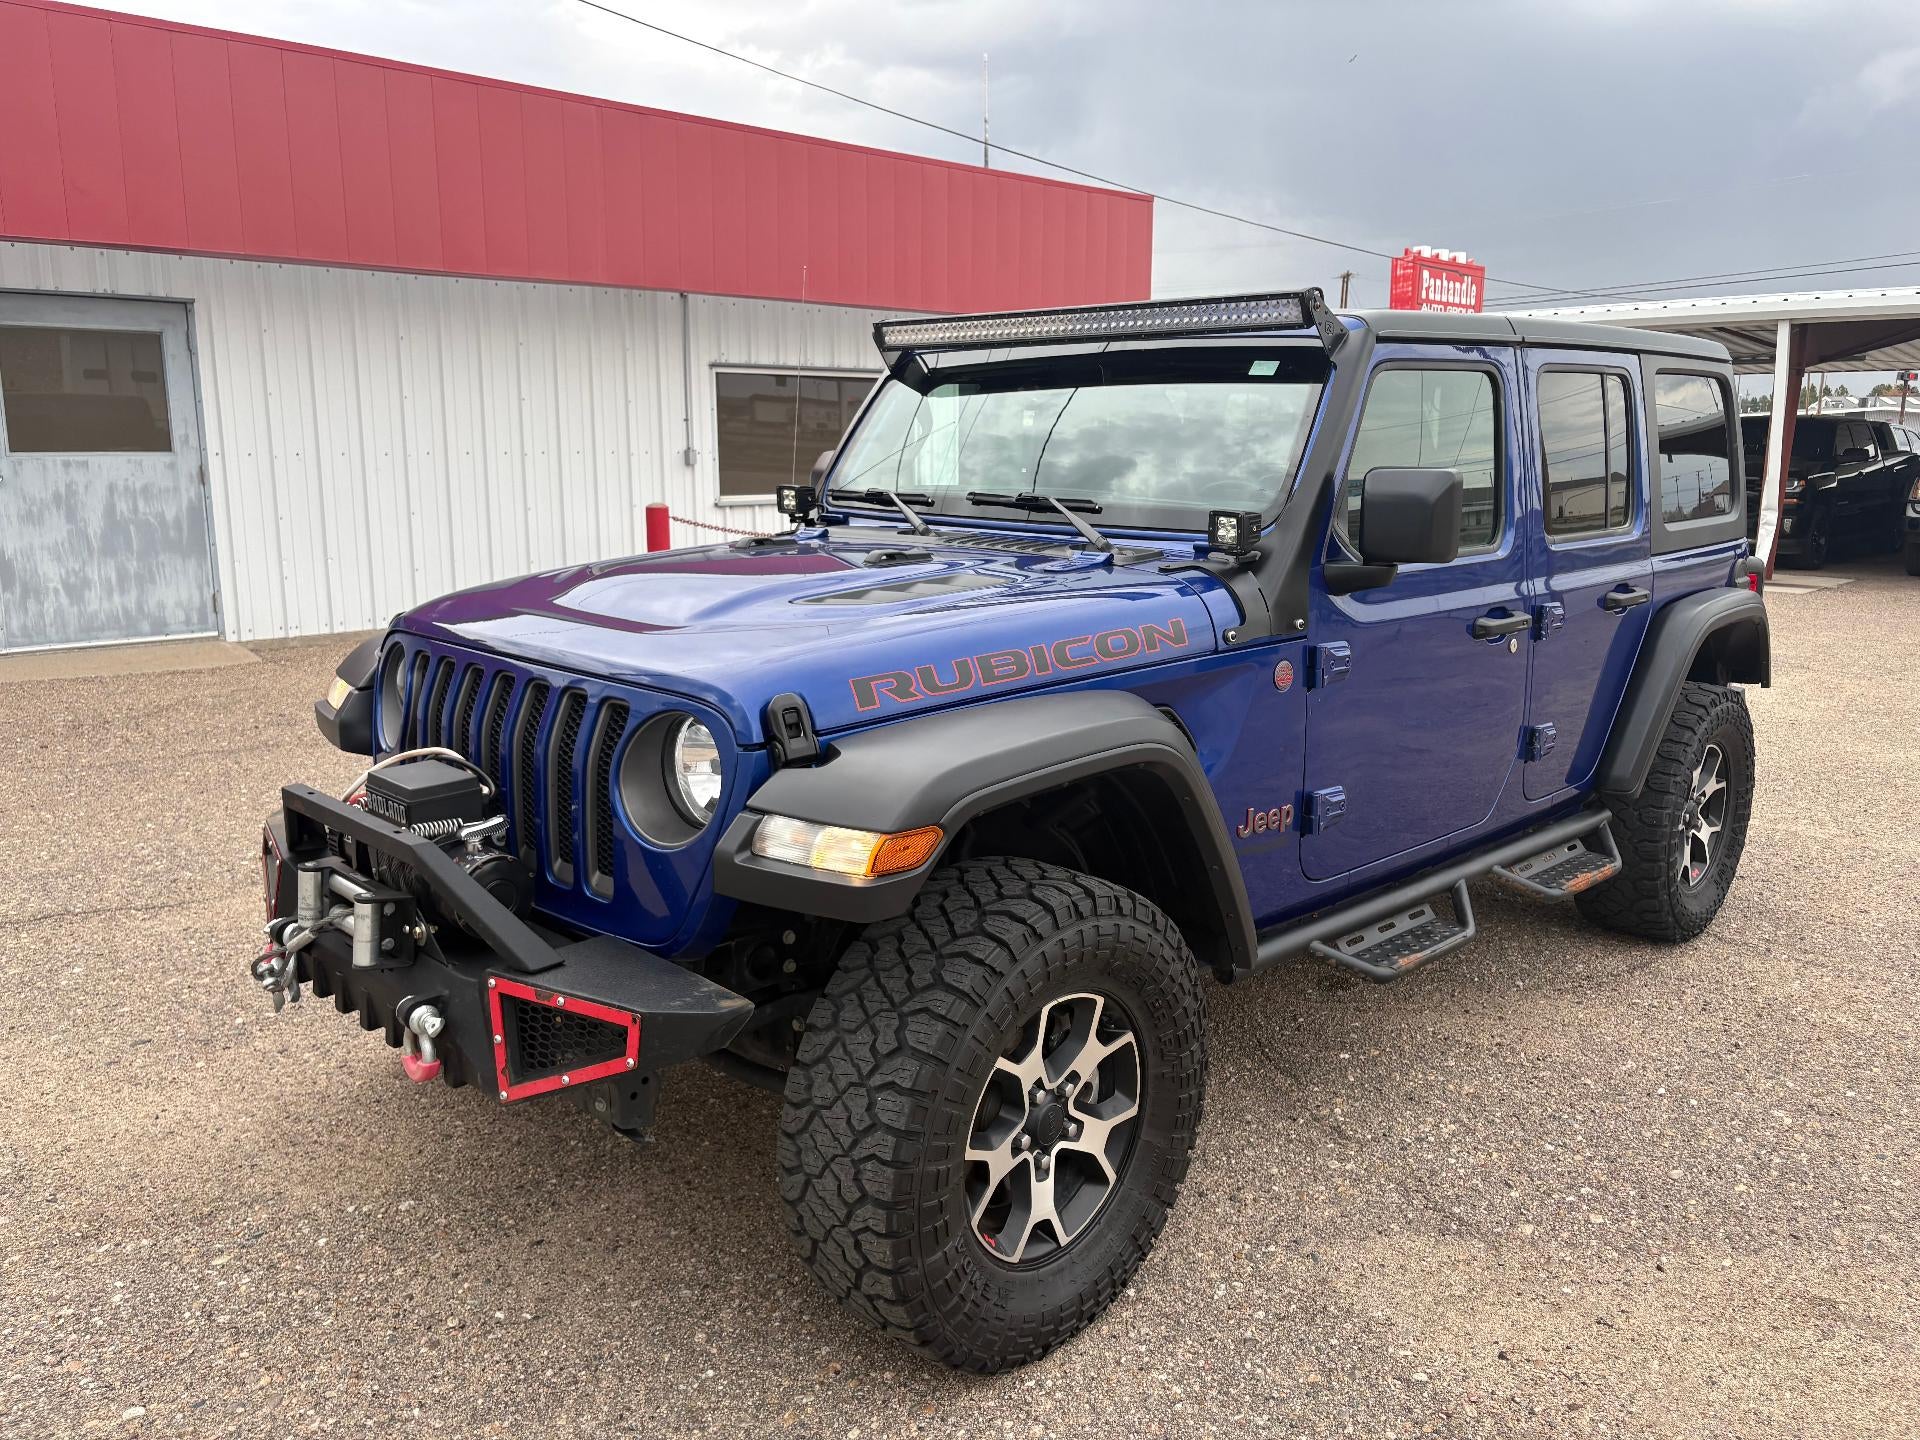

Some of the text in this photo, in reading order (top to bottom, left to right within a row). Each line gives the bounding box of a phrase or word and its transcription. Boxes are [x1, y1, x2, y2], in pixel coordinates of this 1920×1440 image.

[1421, 269, 1477, 306] Panhandle
[1421, 303, 1445, 313] AUTO
[849, 618, 1189, 712] RUBICON
[366, 791, 407, 824] BADLAND
[1237, 804, 1295, 839] Jeep
